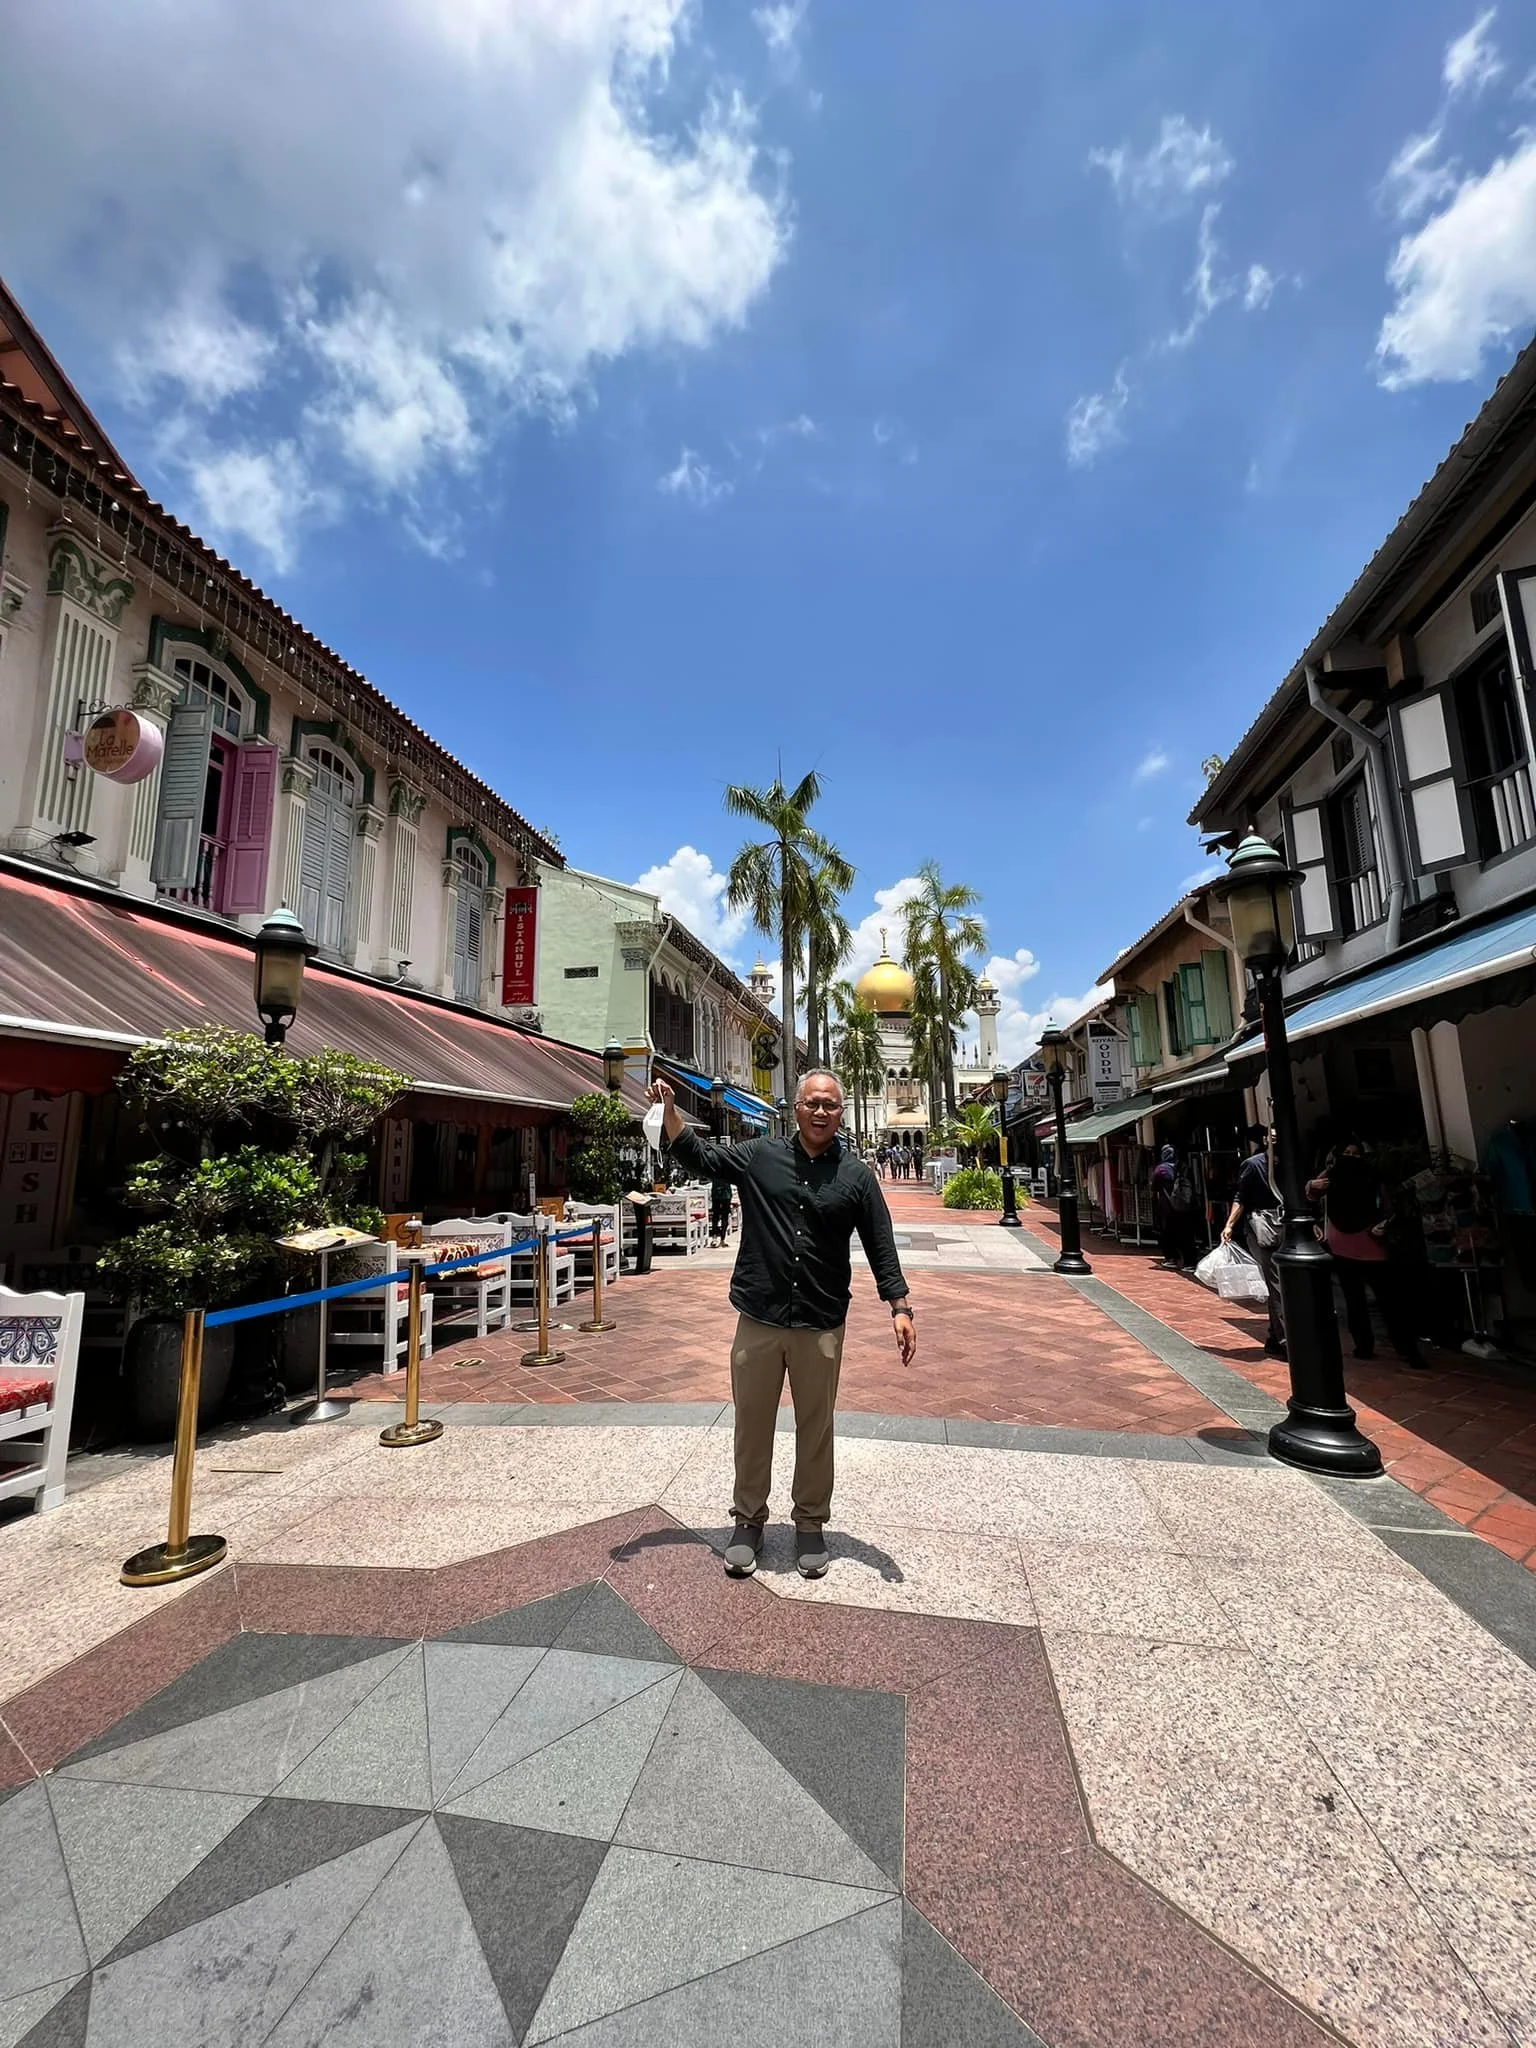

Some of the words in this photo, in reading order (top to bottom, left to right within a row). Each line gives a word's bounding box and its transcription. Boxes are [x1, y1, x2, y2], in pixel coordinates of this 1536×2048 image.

[100, 730, 115, 746] La
[87, 739, 134, 758] Marelle
[514, 915, 526, 977] ISTANBUL
